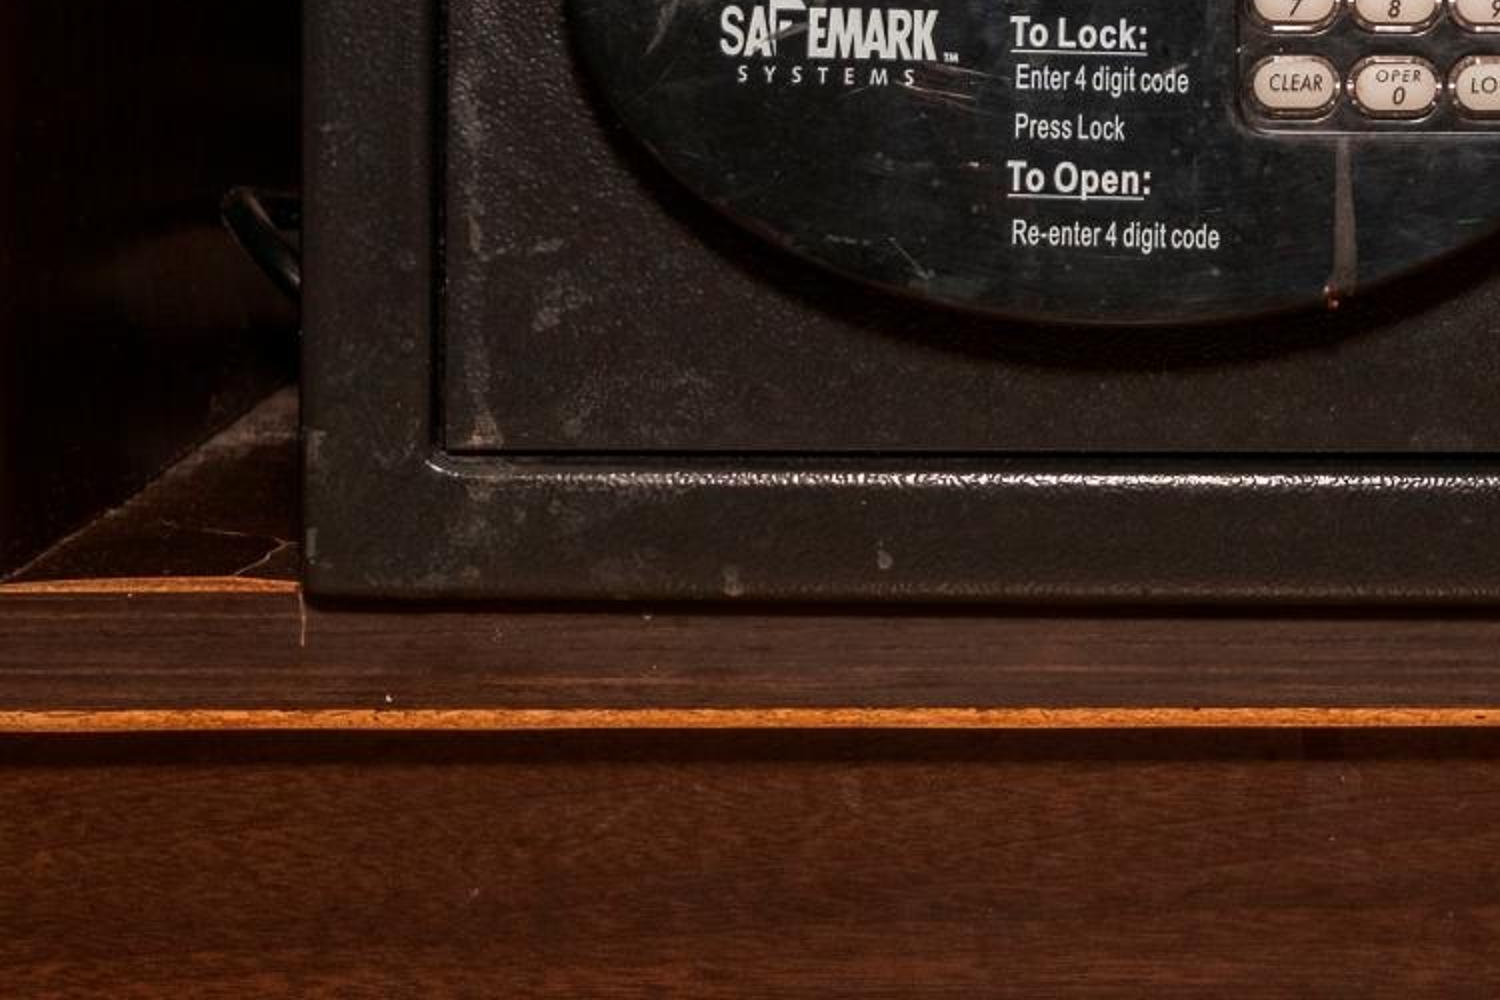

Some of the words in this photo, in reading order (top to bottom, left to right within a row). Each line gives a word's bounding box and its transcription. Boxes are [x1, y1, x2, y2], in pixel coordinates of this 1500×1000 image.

[1010, 15, 1049, 49] To
[1057, 17, 1148, 50] Lock:
[737, 65, 915, 87] SYSTEMS
[1015, 63, 1071, 92] Enter
[1074, 65, 1087, 91] 4
[1091, 65, 1136, 99] digit
[1139, 67, 1189, 95] code
[1269, 73, 1323, 92] CLEAR
[1375, 69, 1421, 83] OPER
[1391, 86, 1406, 106] 0
[1014, 112, 1073, 141] Press
[1077, 113, 1126, 142] Lock
[1007, 159, 1046, 193] To
[1053, 161, 1152, 200] Open:
[1011, 218, 1102, 248] Re-enter
[1104, 220, 1118, 248] 4
[1122, 221, 1167, 255] digit
[1170, 222, 1220, 251] code
